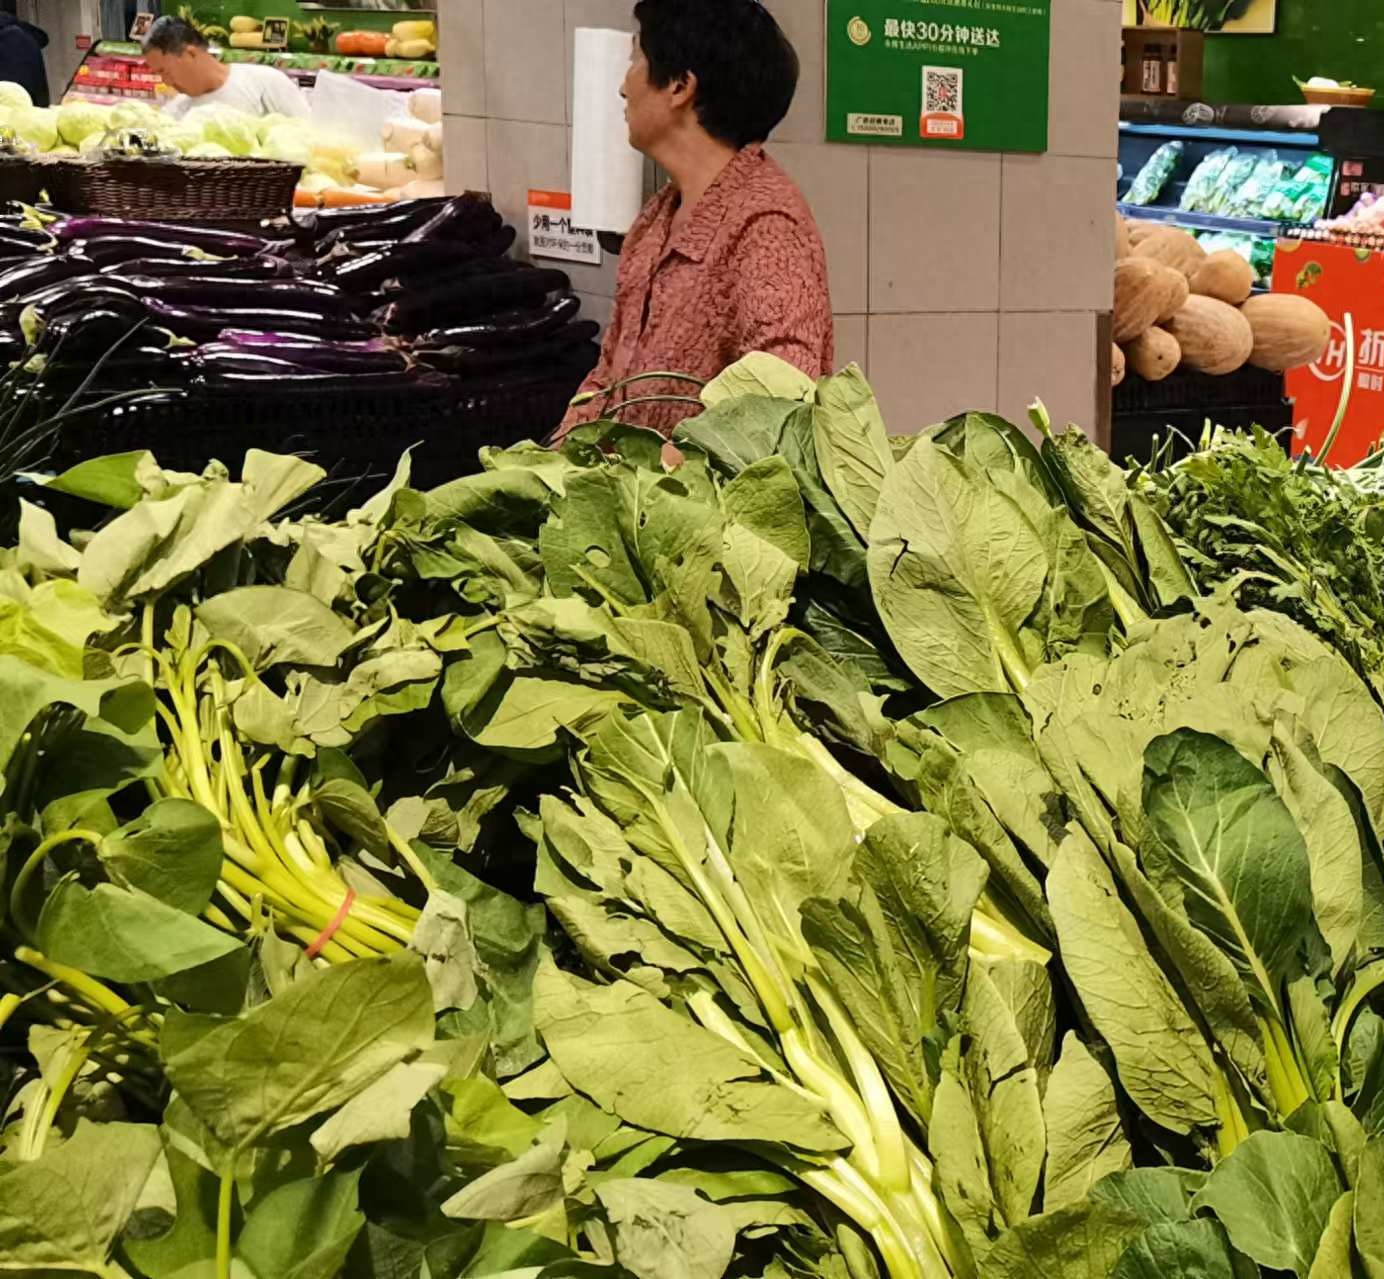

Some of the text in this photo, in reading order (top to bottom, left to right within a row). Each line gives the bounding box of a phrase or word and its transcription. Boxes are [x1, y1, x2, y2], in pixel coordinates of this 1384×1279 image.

[884, 18, 1000, 47] 最快30分钟送达
[533, 213, 594, 238] 少用一个
